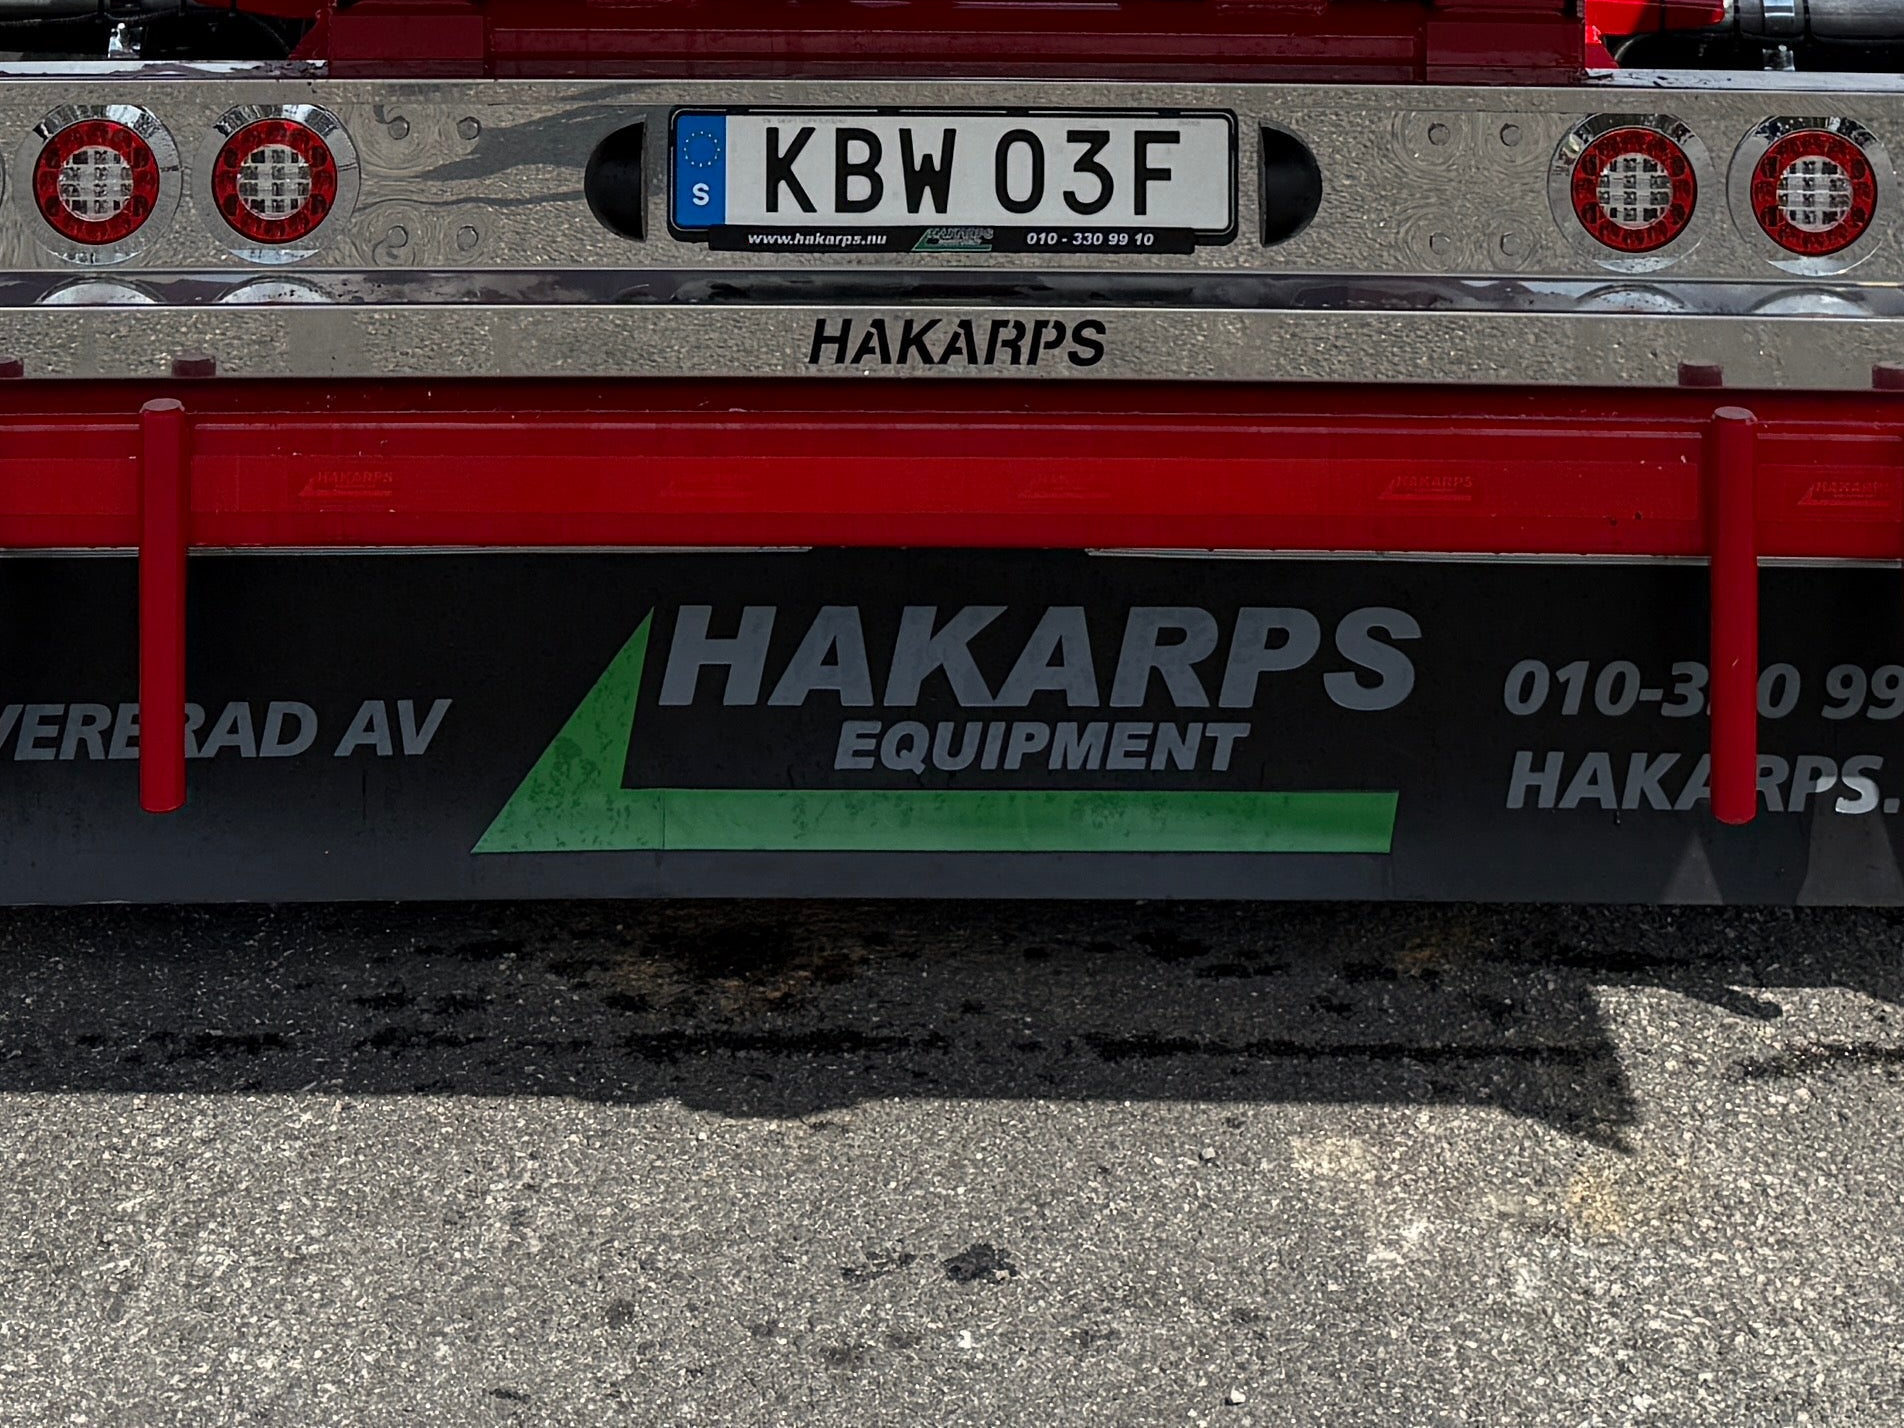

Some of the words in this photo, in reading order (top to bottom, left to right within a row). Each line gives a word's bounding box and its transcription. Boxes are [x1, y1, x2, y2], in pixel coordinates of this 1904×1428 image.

[692, 183, 709, 205] S
[765, 126, 956, 215] KBW
[995, 128, 1181, 216] 03F
[748, 232, 887, 247] www.hakarps.nu
[1027, 232, 1058, 245] 010
[1073, 232, 1105, 245] 330
[1108, 232, 1130, 245] 99
[1134, 232, 1155, 245] 10
[808, 318, 1107, 367] HAKARPS
[658, 604, 1423, 712] HAKARPS
[1503, 659, 1801, 720] 010-30
[334, 698, 453, 757] AV
[833, 720, 1251, 776] EQUIPMENT
